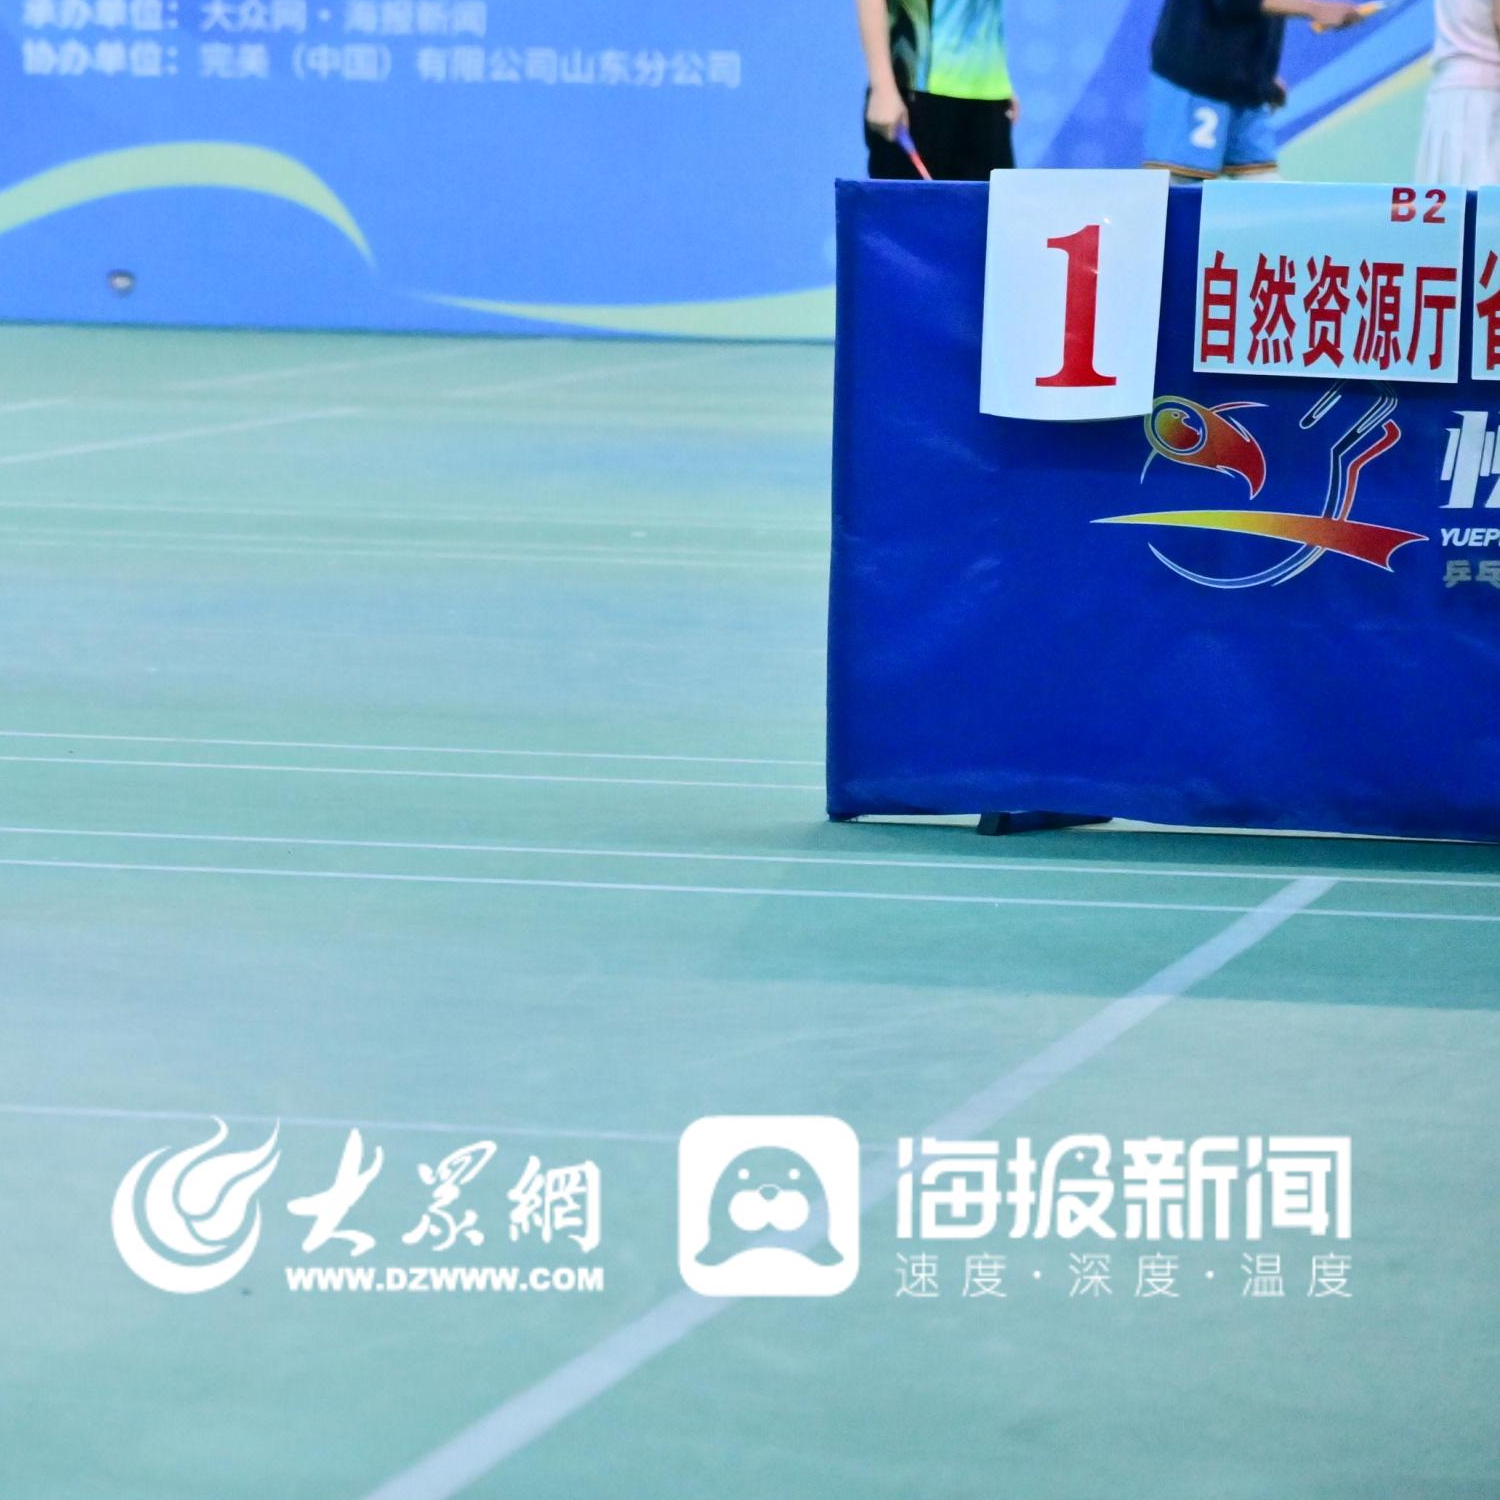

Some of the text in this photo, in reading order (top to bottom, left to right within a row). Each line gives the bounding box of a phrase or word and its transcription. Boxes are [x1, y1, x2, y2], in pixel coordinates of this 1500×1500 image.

[1190, 106, 1220, 150] 2
[1390, 187, 1447, 224] B2
[1035, 224, 1118, 388] 1
[1199, 250, 1458, 372] 自然资源厅
[1440, 527, 1500, 547] YUEP
